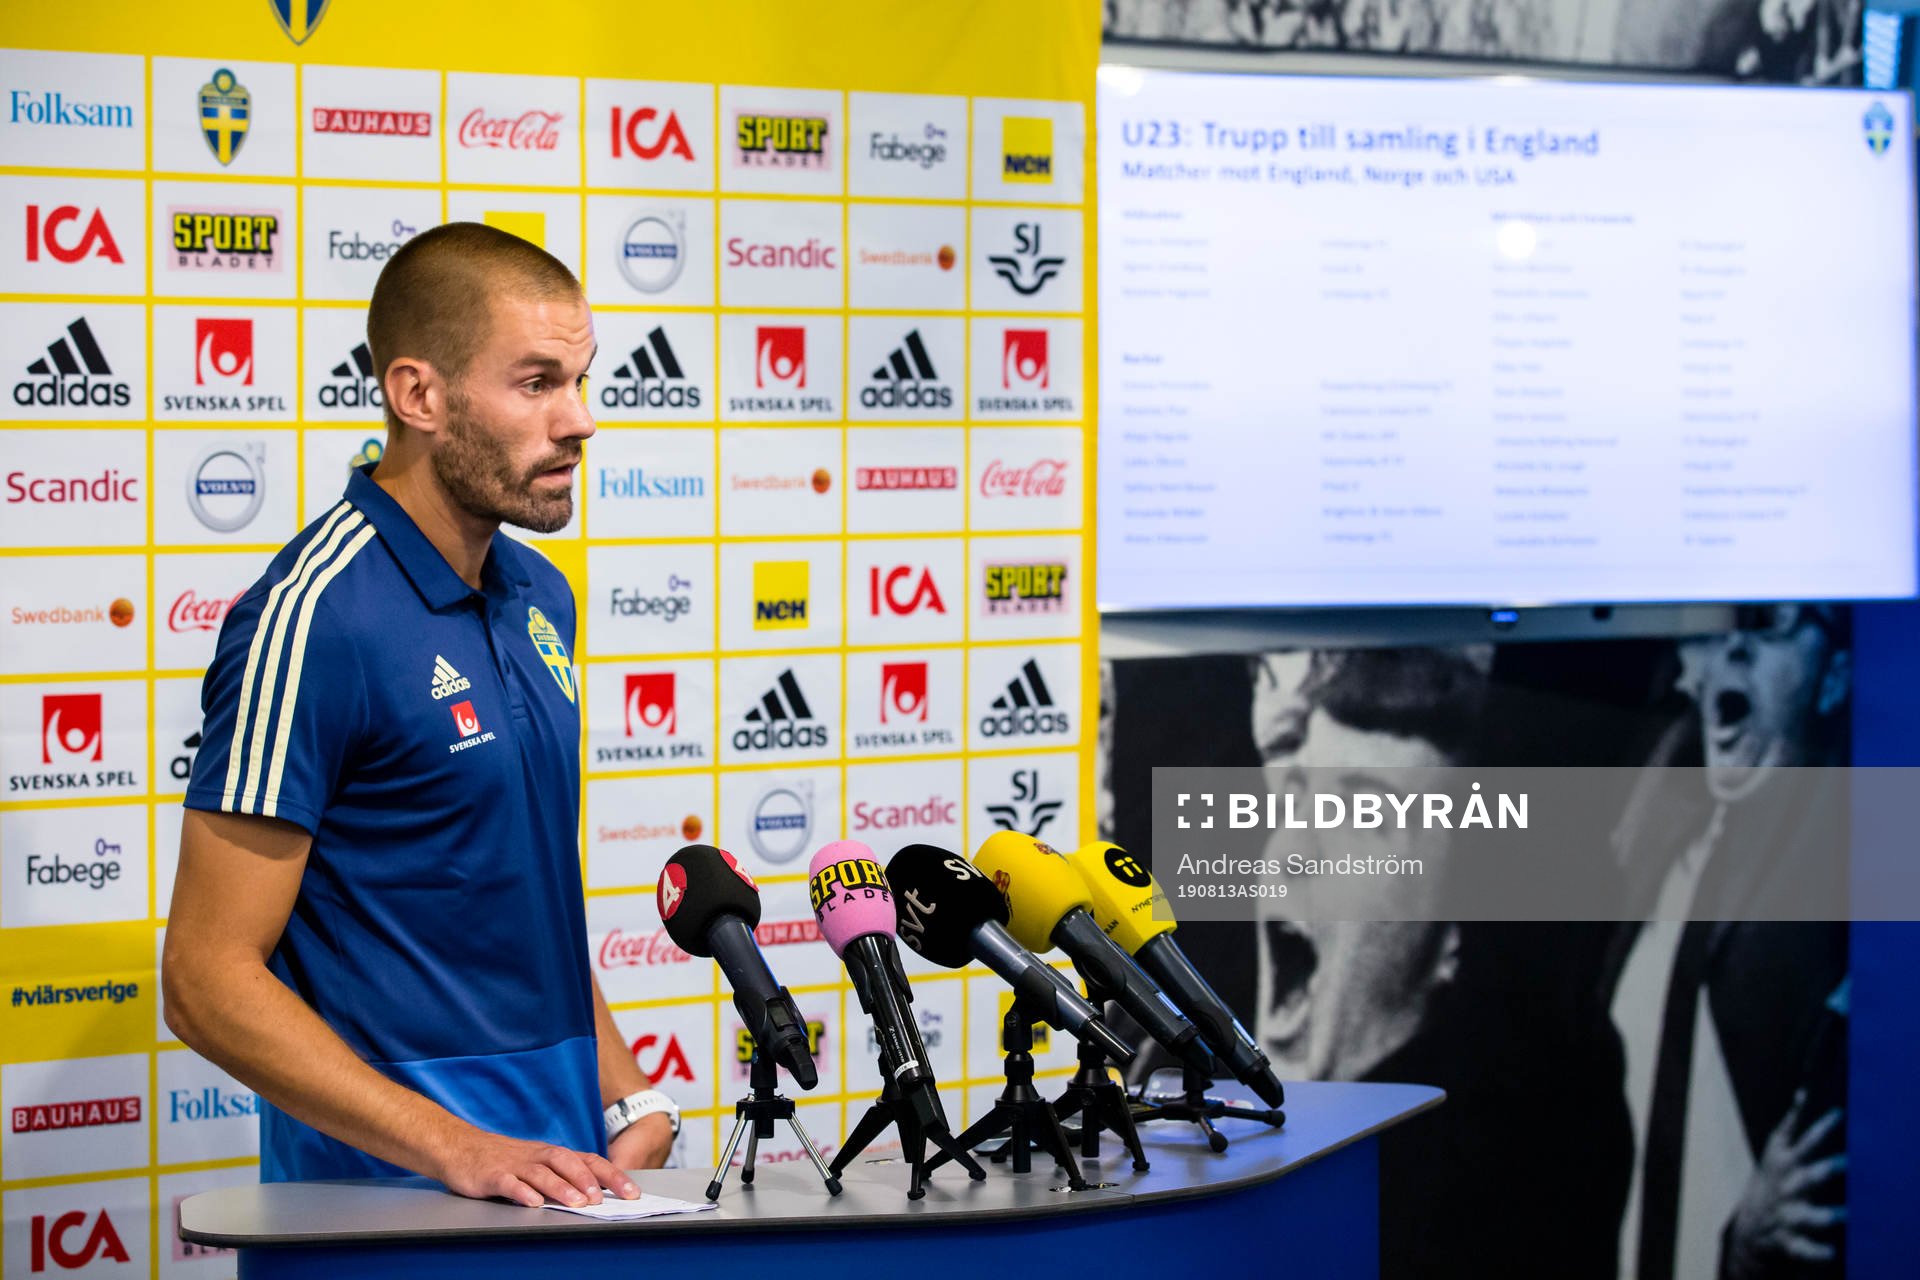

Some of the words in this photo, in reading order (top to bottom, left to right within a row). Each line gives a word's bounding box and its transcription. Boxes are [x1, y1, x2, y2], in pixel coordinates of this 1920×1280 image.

[9, 90, 134, 128] Folksam
[314, 108, 430, 136] BAUHAUS
[612, 106, 695, 161] ICA
[738, 113, 828, 153] SPORT
[1123, 121, 1192, 148] U23:
[1204, 122, 1288, 152] Trupp
[1298, 123, 1336, 149] till
[1346, 126, 1457, 156] samling
[1485, 127, 1599, 160] England
[741, 154, 826, 169] BLADET
[871, 132, 945, 169] Fabege
[26, 204, 125, 264] ICA
[173, 212, 279, 256] SPORT
[1016, 223, 1040, 254] SJ
[178, 254, 274, 270] BLADET
[728, 238, 836, 270] Scandic
[860, 248, 933, 267] Swedbank
[13, 374, 131, 407] adidas
[164, 395, 241, 411] SVENSKA
[247, 397, 286, 412] SPEL
[601, 379, 701, 409] adidas
[730, 397, 795, 413] SVENSKA
[800, 398, 834, 414] SPEL
[861, 381, 953, 410] adidas
[978, 398, 1040, 412] SVENSKA
[1043, 399, 1074, 413] SPEL
[6, 470, 139, 503] Scandic
[198, 479, 255, 495] VOLVO
[599, 468, 704, 499] Folksam
[731, 475, 807, 492] Swedbank
[857, 469, 956, 489] BAUHAUS
[871, 565, 947, 616] ICA
[985, 564, 1066, 601] SPORT
[12, 606, 105, 625] Swedbank
[612, 587, 691, 623] Fabege
[431, 677, 471, 700] adidas
[733, 722, 828, 752] adidas
[854, 732, 920, 749] SVENSKA
[922, 729, 954, 745] SPEL
[980, 710, 1069, 739] adidas
[449, 738, 481, 754] SVENSKA
[481, 731, 497, 744] SPEL
[596, 745, 667, 764] SVENSKA
[670, 741, 704, 759] SPEL
[10, 773, 90, 792] SVENSKA
[93, 770, 137, 788] SPEL
[1011, 769, 1036, 800] SJ
[853, 795, 957, 831] Scandic
[598, 825, 677, 843] Swedbank
[28, 854, 121, 890] Fabege
[12, 981, 138, 1007] #viärsverige
[13, 1098, 141, 1132] BAUHAUS
[31, 1209, 129, 1273] ICA
